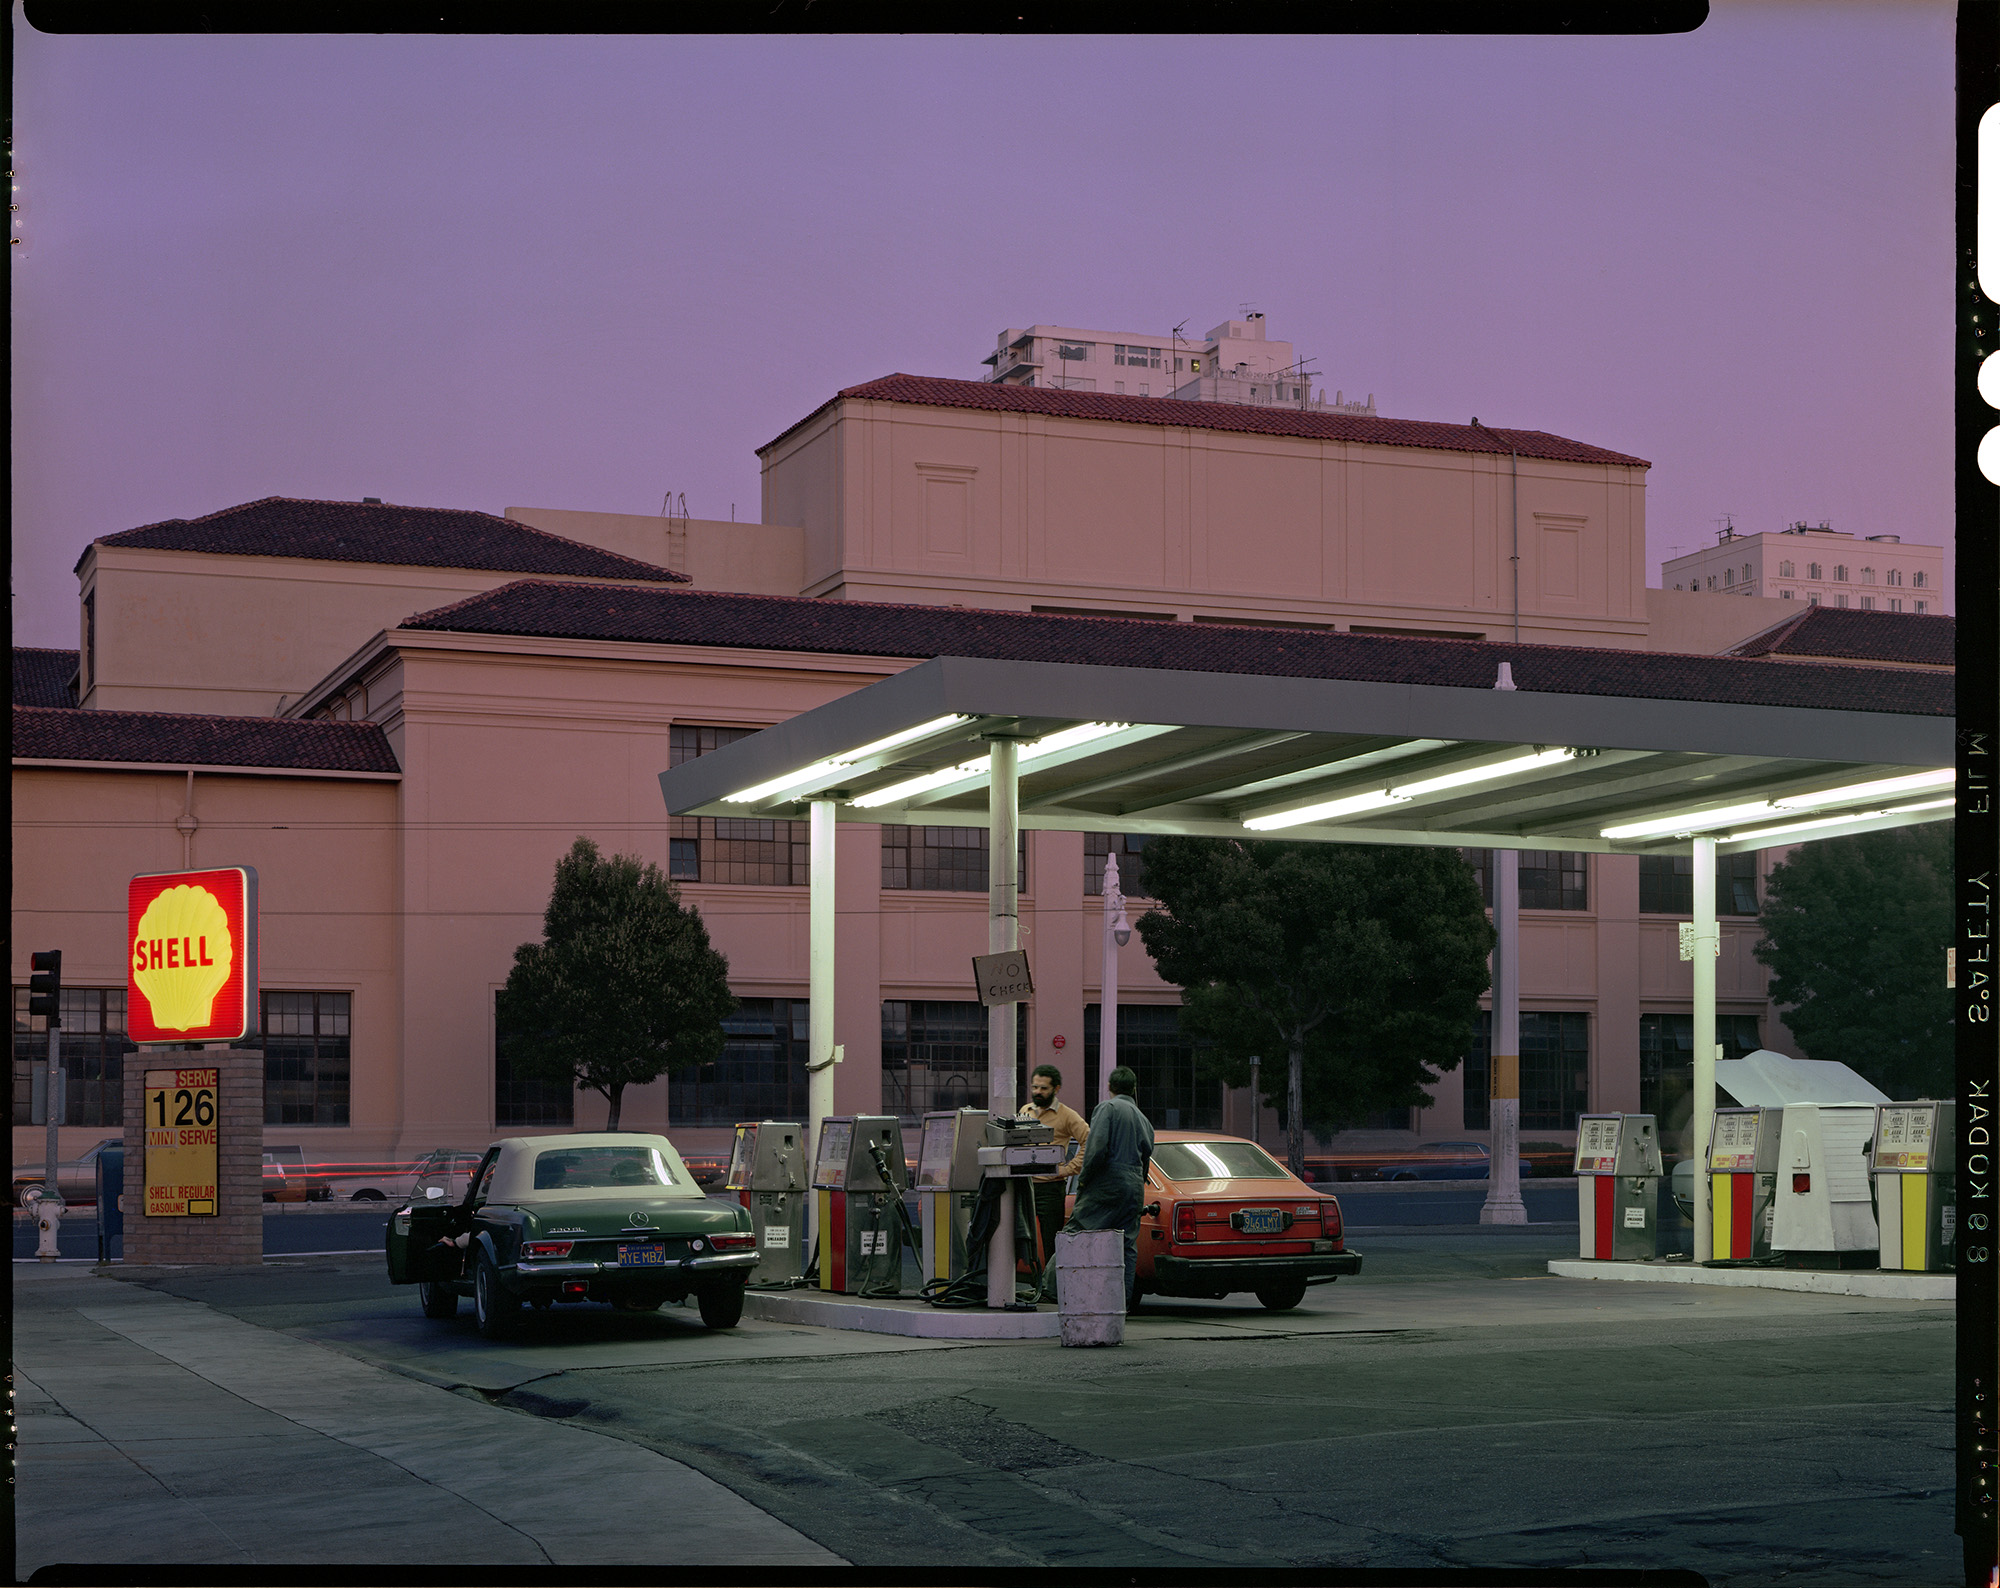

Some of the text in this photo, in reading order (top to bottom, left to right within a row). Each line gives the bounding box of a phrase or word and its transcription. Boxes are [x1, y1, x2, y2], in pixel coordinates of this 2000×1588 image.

[136, 935, 214, 972] SHELL
[990, 962, 1020, 977] NO
[989, 982, 1030, 996] CHECK
[179, 1070, 217, 1087] SERVE
[153, 1089, 215, 1127] 126
[149, 1129, 217, 1145] MINI SERVE
[149, 1185, 215, 1199] SHELL REGULAR
[150, 1202, 185, 1213] GASOLINE
[1244, 1217, 1278, 1229] 946 LMY
[620, 1251, 664, 1264] MYE MBZ
